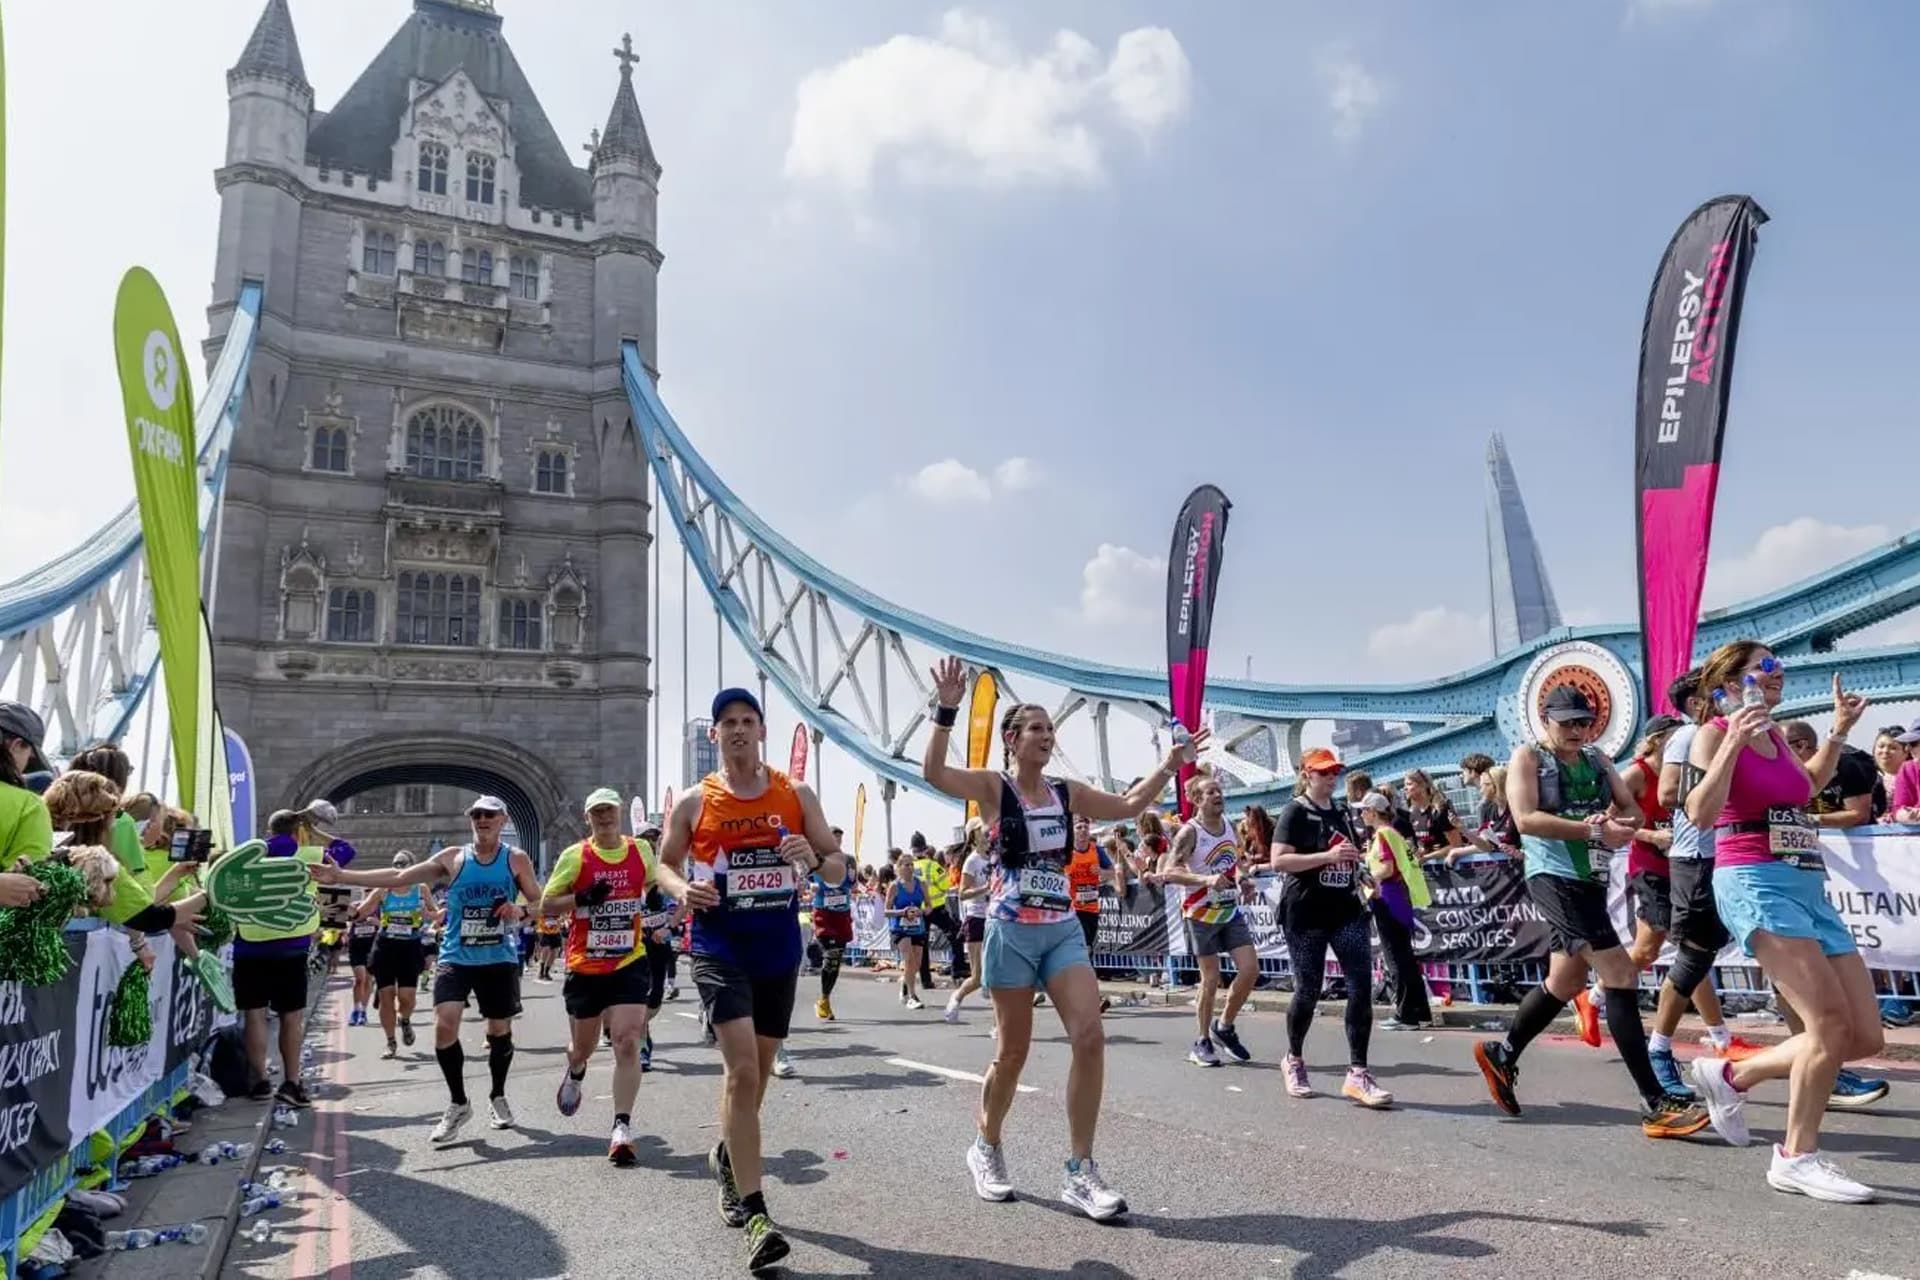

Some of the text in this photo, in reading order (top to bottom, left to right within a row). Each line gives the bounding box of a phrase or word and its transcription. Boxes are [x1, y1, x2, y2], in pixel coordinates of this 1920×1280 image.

[1657, 269, 1704, 443] EPILEPSY
[1178, 525, 1201, 635] EPILEPSY
[737, 871, 782, 891] 26429
[1030, 876, 1064, 894] 63024
[1320, 872, 1350, 885] GABS
[1435, 885, 1486, 906] TATA
[1827, 891, 1920, 917] ULTAN
[595, 934, 627, 946] 34841
[1439, 928, 1517, 950] SERVICES
